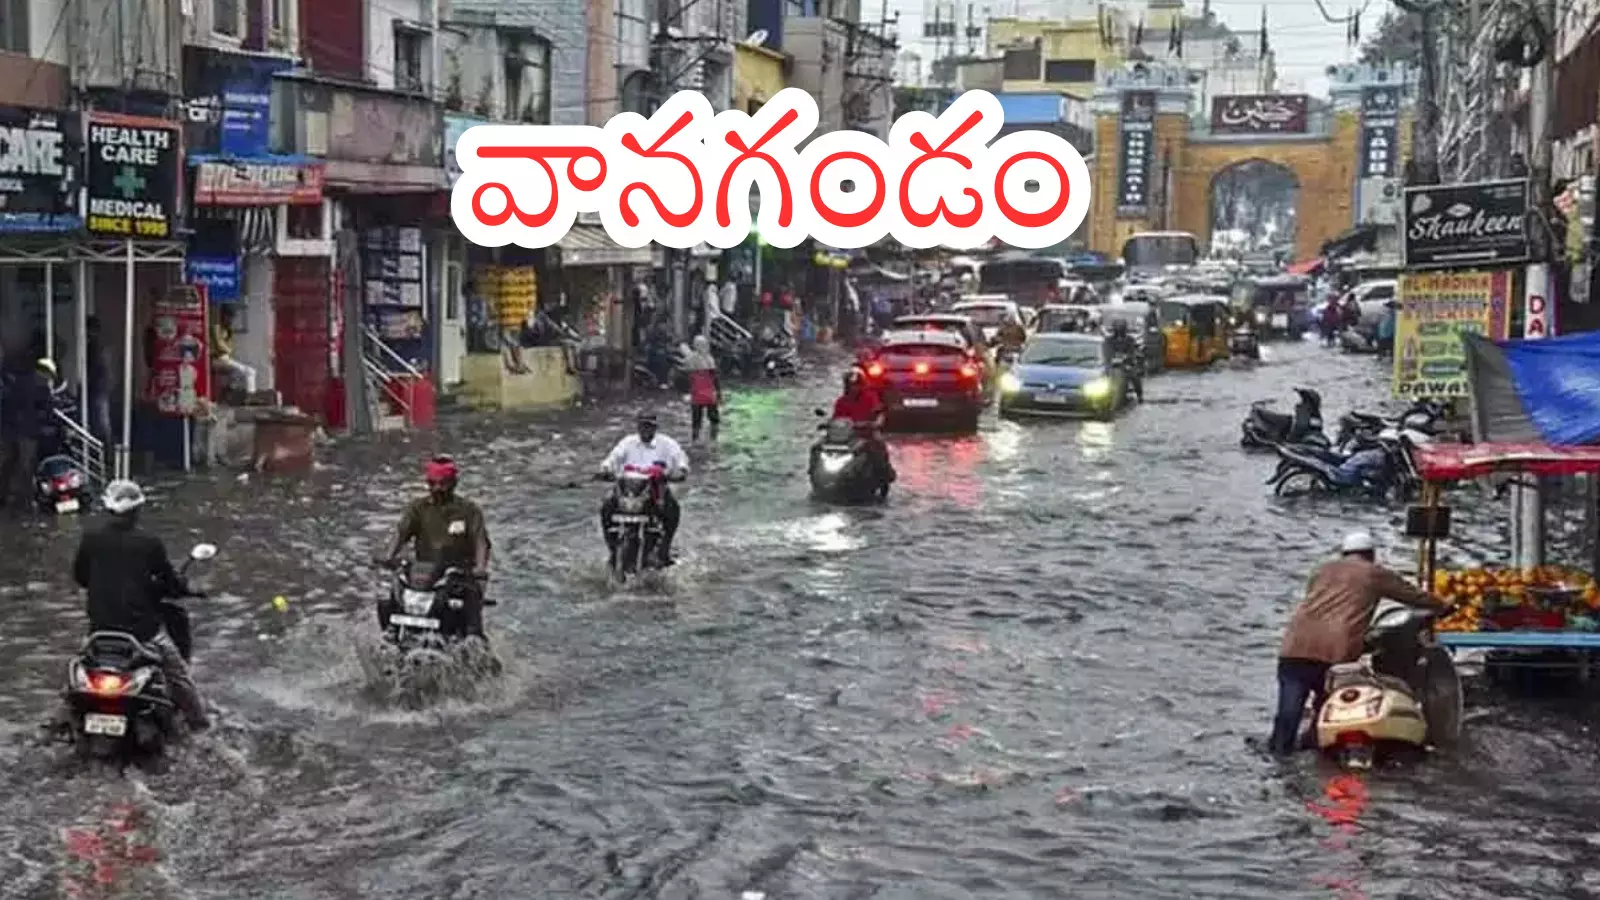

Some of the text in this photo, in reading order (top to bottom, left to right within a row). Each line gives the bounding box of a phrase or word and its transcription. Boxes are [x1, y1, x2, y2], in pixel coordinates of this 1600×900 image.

[91, 126, 169, 149] HEALTH
[101, 145, 158, 165] CARE
[90, 199, 166, 220] MEDICAL
[1408, 208, 1522, 241] Shaukeen
